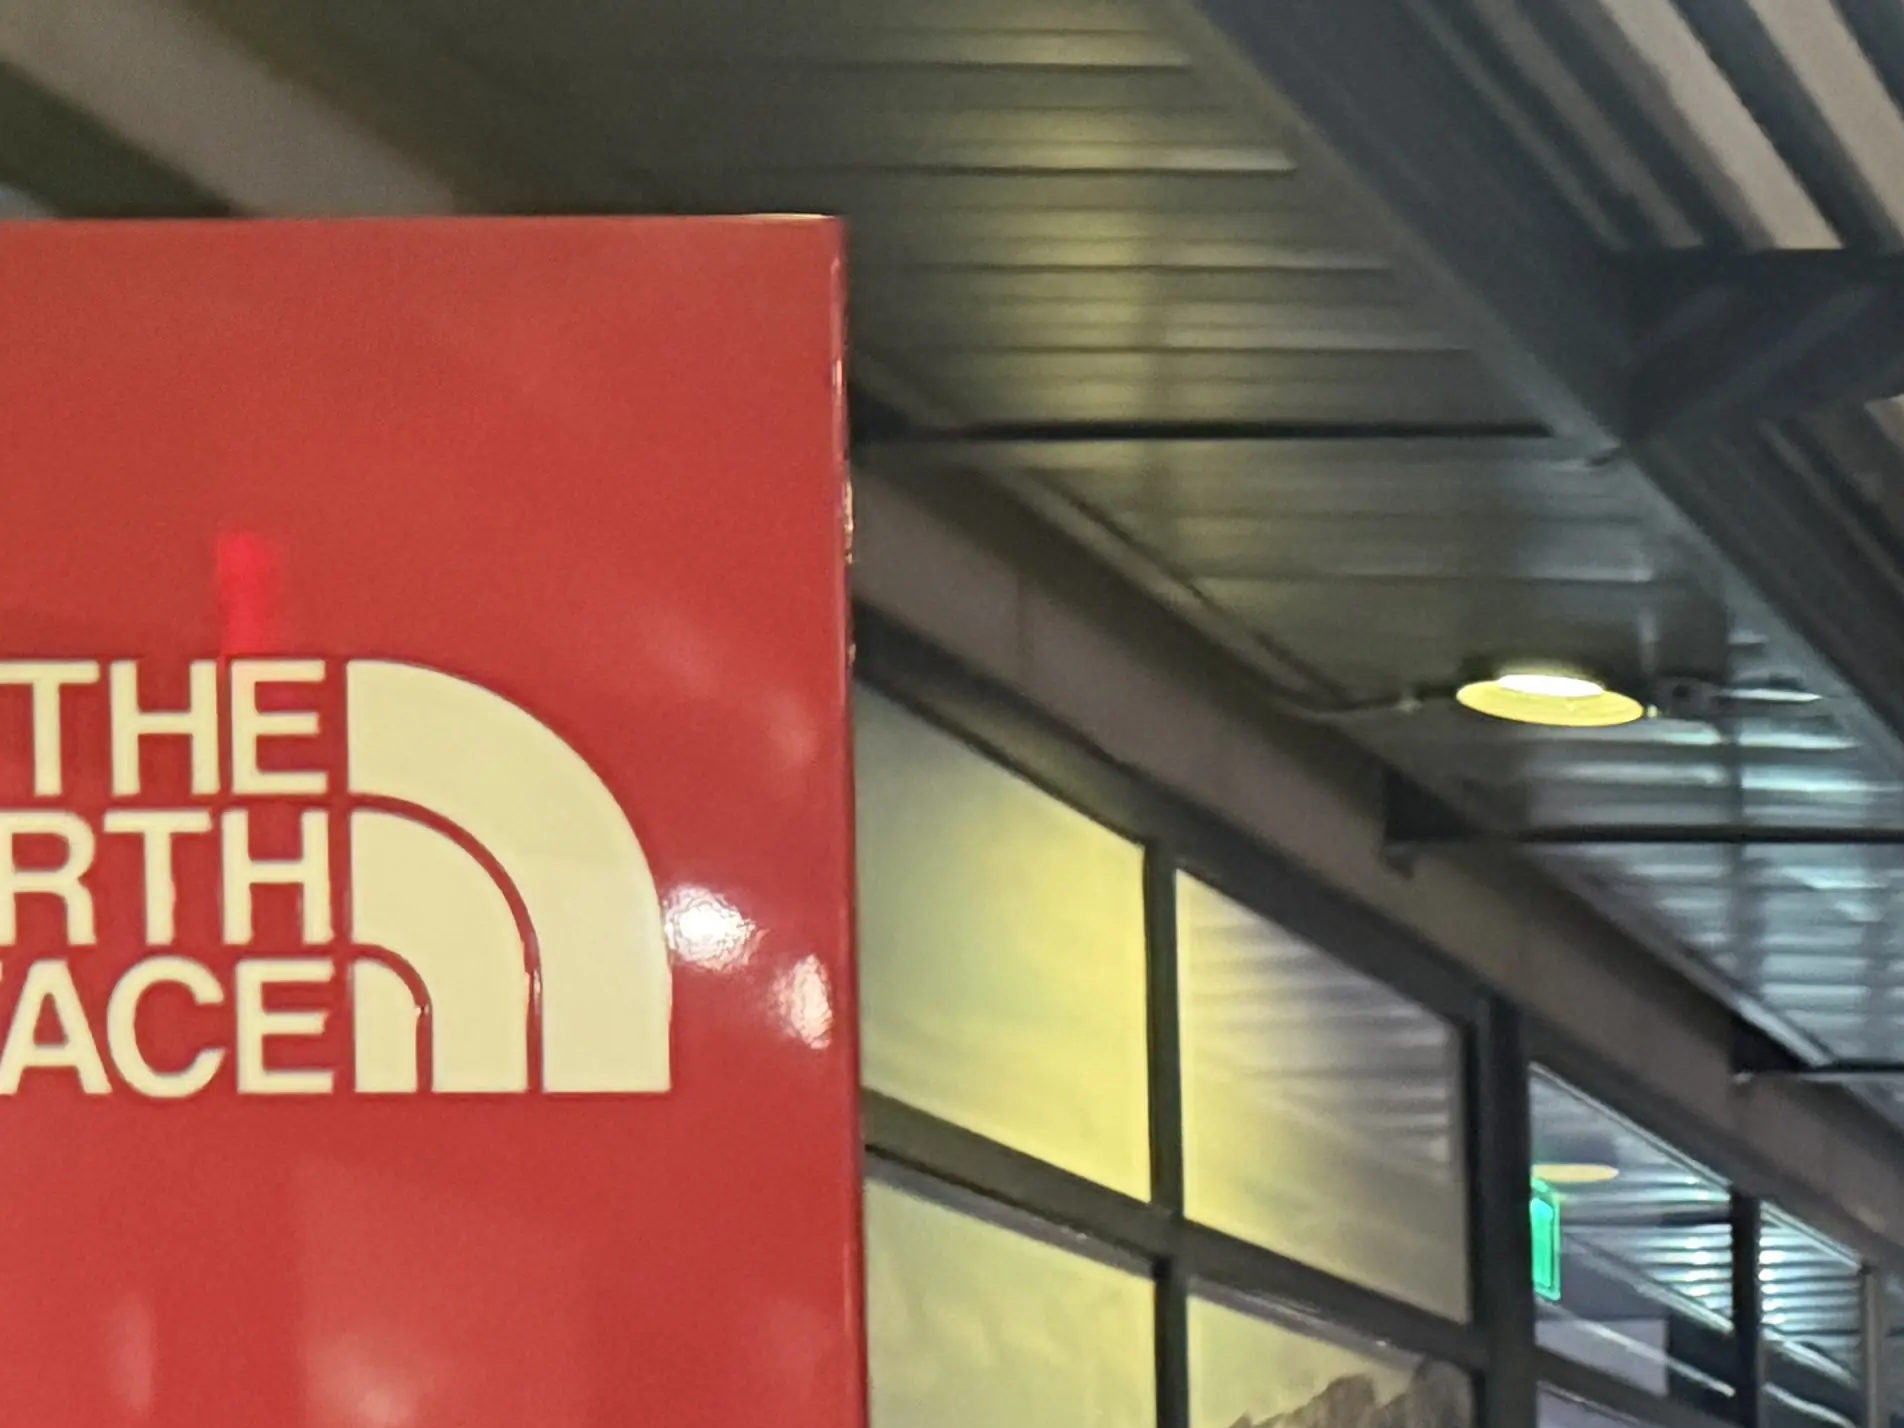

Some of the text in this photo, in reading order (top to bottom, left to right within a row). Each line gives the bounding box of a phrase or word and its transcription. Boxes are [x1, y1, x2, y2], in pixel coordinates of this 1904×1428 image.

[0, 660, 327, 796] THE
[0, 809, 334, 946] RTH
[0, 956, 335, 1098] ACE
